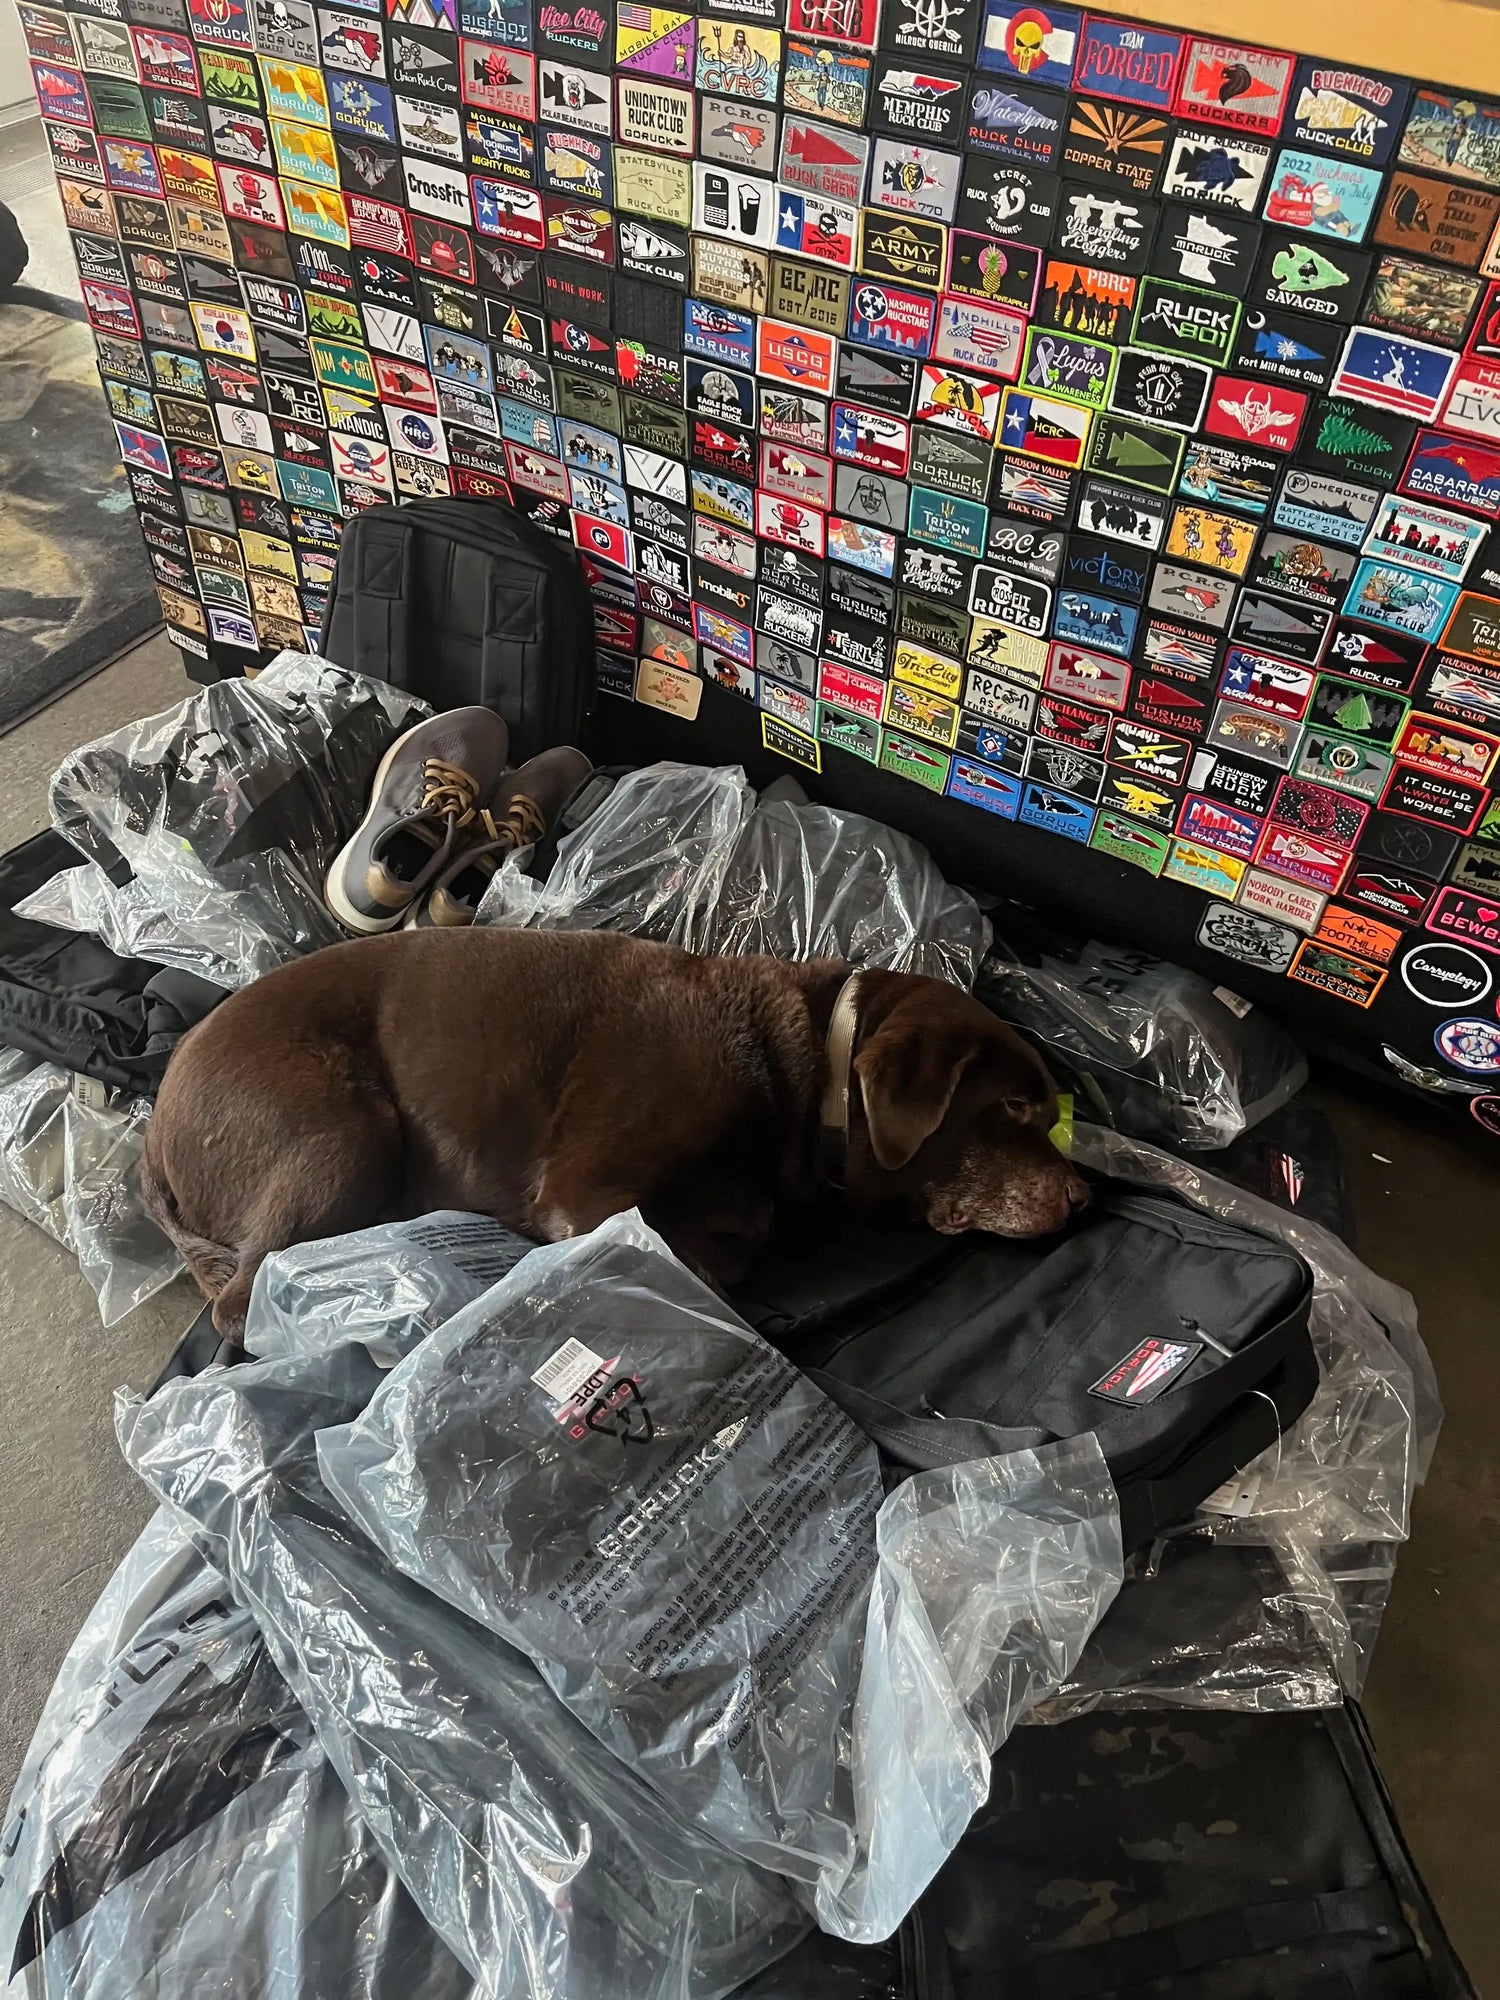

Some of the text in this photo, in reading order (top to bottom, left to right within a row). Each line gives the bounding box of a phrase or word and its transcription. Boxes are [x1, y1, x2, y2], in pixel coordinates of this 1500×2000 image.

[192, 22, 251, 43] GORUCK
[462, 14, 528, 35] BIGFOOT
[619, 16, 683, 57] MOBILE BAY
[630, 24, 691, 64] RUCK CLUB
[1119, 32, 1144, 49] TEAM
[1084, 40, 1175, 92] FORGED
[1200, 45, 1285, 68] LION CITY
[468, 82, 531, 107] BUCKEYE
[704, 70, 766, 98] CVRC
[625, 89, 687, 117] UNIONTOWN
[883, 96, 951, 123] MEMPHIS
[336, 112, 385, 133] GORUCK
[470, 112, 523, 133] MONTANA
[628, 110, 684, 133] RUCK CLUB
[888, 112, 943, 133] RUCK CLUB
[1188, 104, 1269, 129] RUCKERS
[485, 139, 520, 155] GORUCK
[625, 129, 673, 146] GORUCK
[472, 154, 531, 179] MIGHTY RUCKS
[1282, 156, 1364, 184] 2022 Ruckmas
[407, 172, 469, 207] CrossFit
[1336, 183, 1373, 207] in July
[354, 207, 377, 219] RUCK
[881, 194, 943, 216] RUCK 770
[870, 235, 935, 262] ARMY
[80, 260, 123, 277] GORUCK
[166, 260, 177, 268] 5K
[623, 258, 685, 283] RUCK CLUB
[917, 264, 938, 277] GRT
[135, 277, 182, 295] GORUCK
[1087, 269, 1130, 293] PBRC
[364, 284, 414, 306] C.A.R.C.
[888, 298, 929, 317] NASHVILLE
[1266, 289, 1339, 316] SAVAGED
[887, 310, 929, 329] RUCKSTARS
[1156, 297, 1232, 331] RUCK
[146, 325, 194, 345] GORUCK
[1179, 325, 1228, 348] 801
[354, 359, 370, 379] GRT
[553, 350, 615, 375] RUCKSTARS
[1053, 345, 1105, 381] Lupus
[1238, 356, 1324, 385] Fort Mill Ruck Club
[496, 376, 550, 402] GORUCK
[1051, 384, 1101, 404] AWARENESS
[1318, 399, 1356, 416] PNW
[404, 424, 430, 441] HRC
[1034, 421, 1065, 439] HCRC
[395, 453, 445, 475] PUG POWER
[1005, 455, 1071, 480] HUDSON VALLEY
[1190, 442, 1277, 471] HAMPTON ROADS
[1218, 457, 1252, 473] GRT
[1346, 458, 1392, 480] TOUGH
[396, 460, 446, 481] RUCK CLUB
[515, 471, 565, 495] GORUCK
[291, 478, 325, 495] TRITON
[766, 475, 825, 499] GORUCK
[1310, 480, 1376, 504] CHEROKEE
[1408, 479, 1480, 505] RUCK CLUB
[1411, 468, 1500, 500] CABARRUS
[697, 497, 749, 523] MUNICH
[802, 492, 825, 506] TOUGH
[1007, 501, 1053, 522] RUCK CLUB
[1277, 513, 1361, 543] RUCK 2019
[1279, 505, 1365, 532] BATTLESHIP ROW
[766, 526, 815, 550] CLT RC
[195, 550, 242, 572] GORUCK
[202, 572, 222, 585] RVA
[1162, 567, 1228, 591] P.C.R.C.
[1267, 570, 1328, 594] GORUCK
[697, 577, 750, 608] imobile3
[642, 601, 692, 629] GORUCK
[759, 590, 822, 623] VEGASSTRONG
[215, 616, 252, 641] F45
[764, 620, 812, 647] RUCKERS
[1150, 619, 1218, 645] HUDSON VALLEY
[897, 652, 959, 683] Tri-City
[1150, 663, 1196, 682] RUCK CLUB
[1349, 667, 1403, 688] RUCK ICT
[1053, 675, 1119, 700] GORUCK
[761, 694, 812, 727] TULSA
[772, 707, 812, 732] OKLAHOMA
[1433, 700, 1487, 723] RUCK CLUB
[765, 720, 803, 745] GORUCK
[767, 733, 815, 762] HYROX
[1394, 785, 1474, 813] ALWAYS BE
[1404, 775, 1472, 802] IT COULD
[1402, 796, 1457, 819] WORSE.
[1246, 890, 1313, 922] WORK HARDER
[1249, 878, 1317, 912] NOBODY CARES
[1319, 924, 1391, 957] FOOTHILLS
[1294, 970, 1367, 1003] RUCKERS
[1298, 964, 1370, 996] WEST ORANGE
[1411, 958, 1482, 991] Carryology
[1453, 1051, 1498, 1065] BASEBALL
[1099, 1340, 1160, 1392] GORUCK
[569, 1364, 610, 1410] LDPE
[826, 1504, 864, 1548] breathing.
[681, 1484, 775, 1597] mince adhérer au nez
[693, 1487, 790, 1608] parcs ou les poussettes des
[742, 1531, 774, 1567] enfants.
[773, 1546, 868, 1664] Do not use this bag in cribs,
